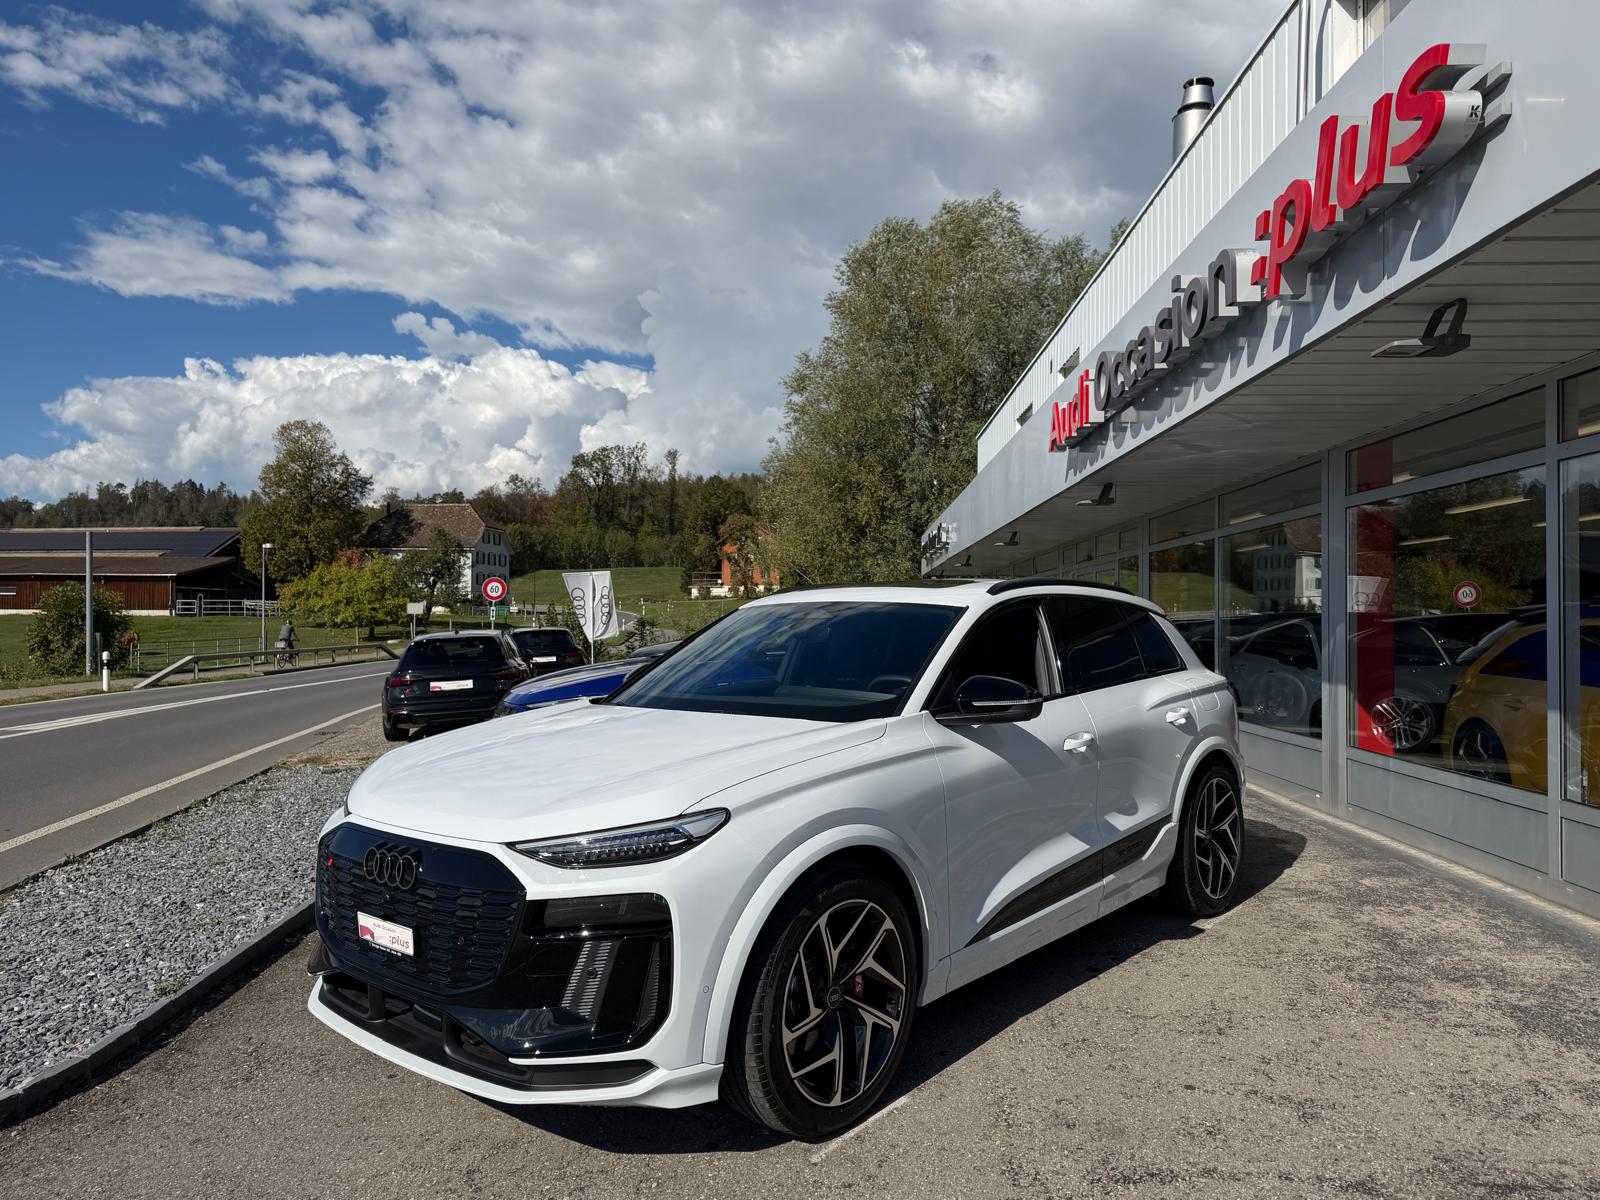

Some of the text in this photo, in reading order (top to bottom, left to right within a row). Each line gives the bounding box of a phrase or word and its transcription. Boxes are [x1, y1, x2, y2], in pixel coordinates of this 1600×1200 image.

[1049, 43, 1450, 453] Audi Occasion :plus
[490, 585, 499, 593] 60
[389, 936, 410, 949] :plus
